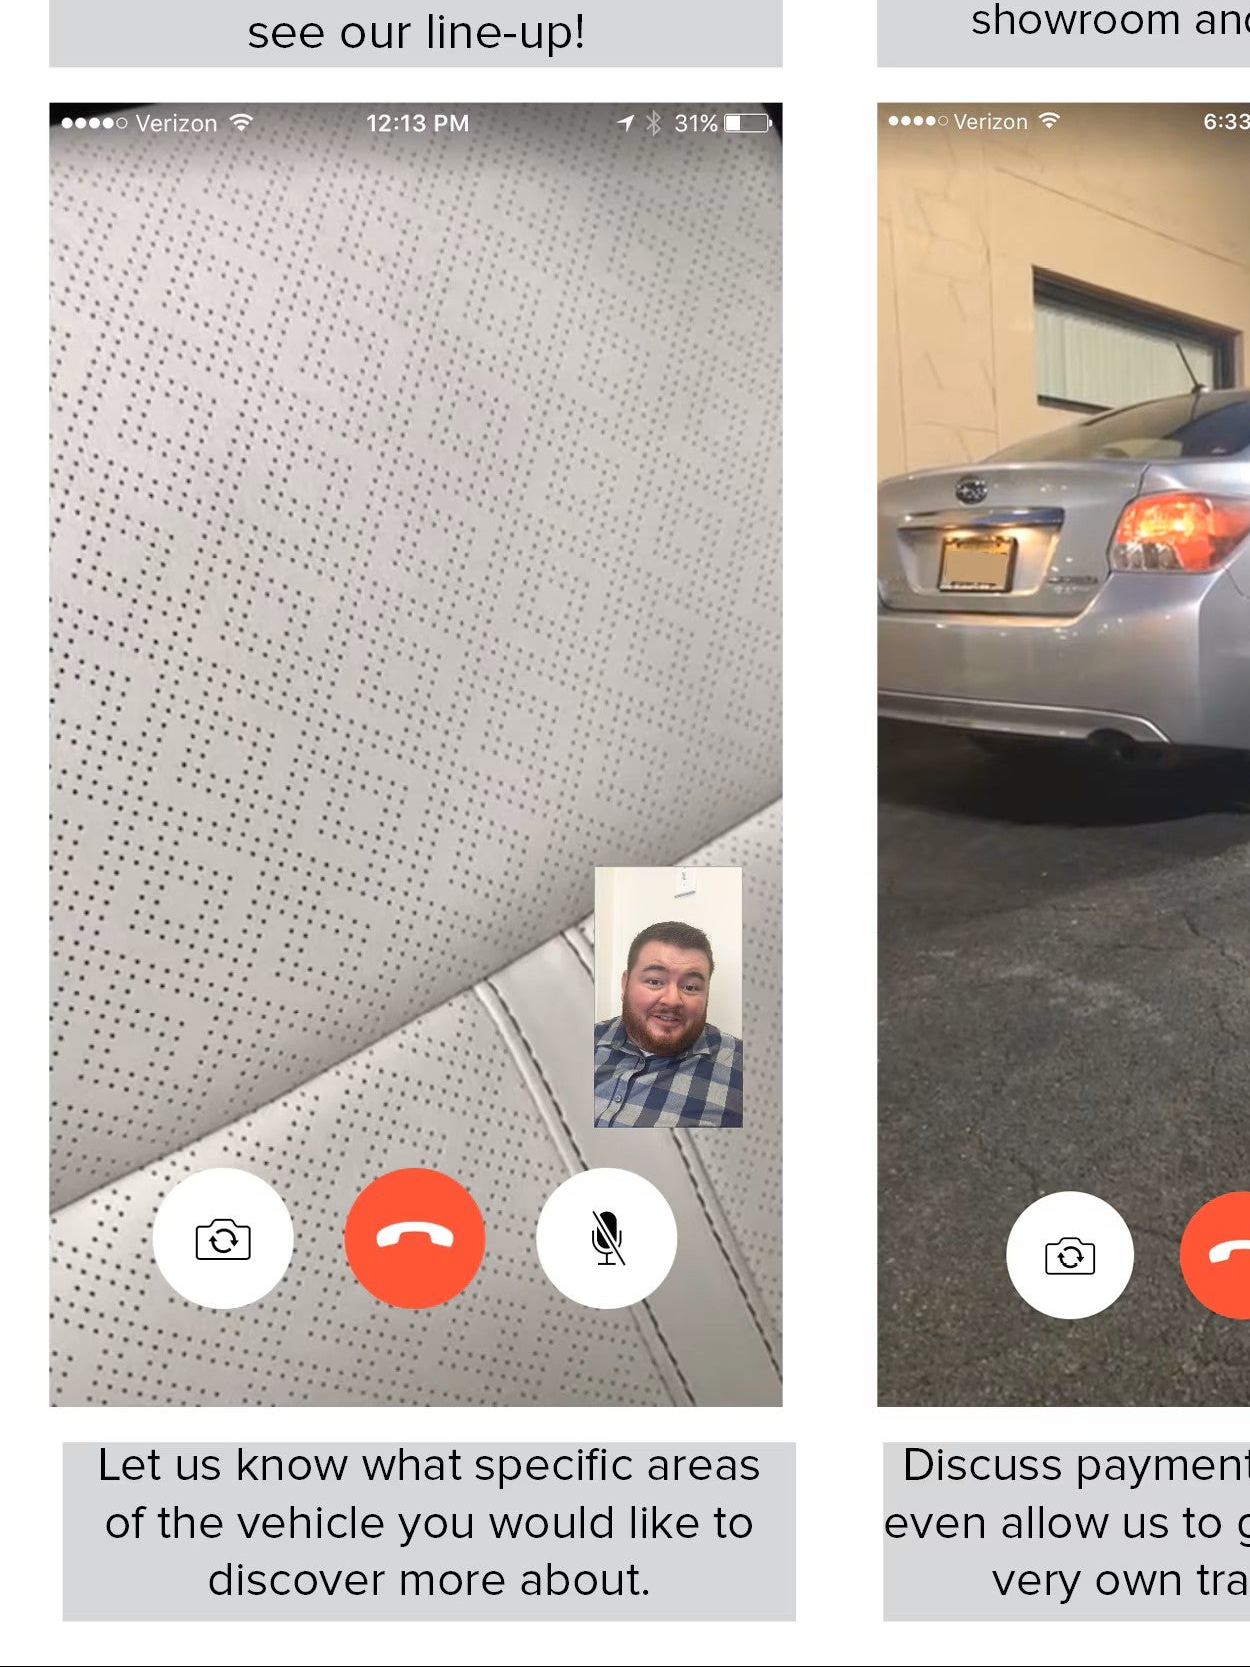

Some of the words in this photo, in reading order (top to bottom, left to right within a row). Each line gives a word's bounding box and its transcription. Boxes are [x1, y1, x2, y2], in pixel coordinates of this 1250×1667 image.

[135, 113, 217, 132] Verizon
[367, 114, 426, 133] 12:13
[434, 114, 469, 132] PM
[675, 114, 718, 133] 31%
[953, 113, 1028, 130] Verizon
[1204, 113, 1250, 130] 6:33
